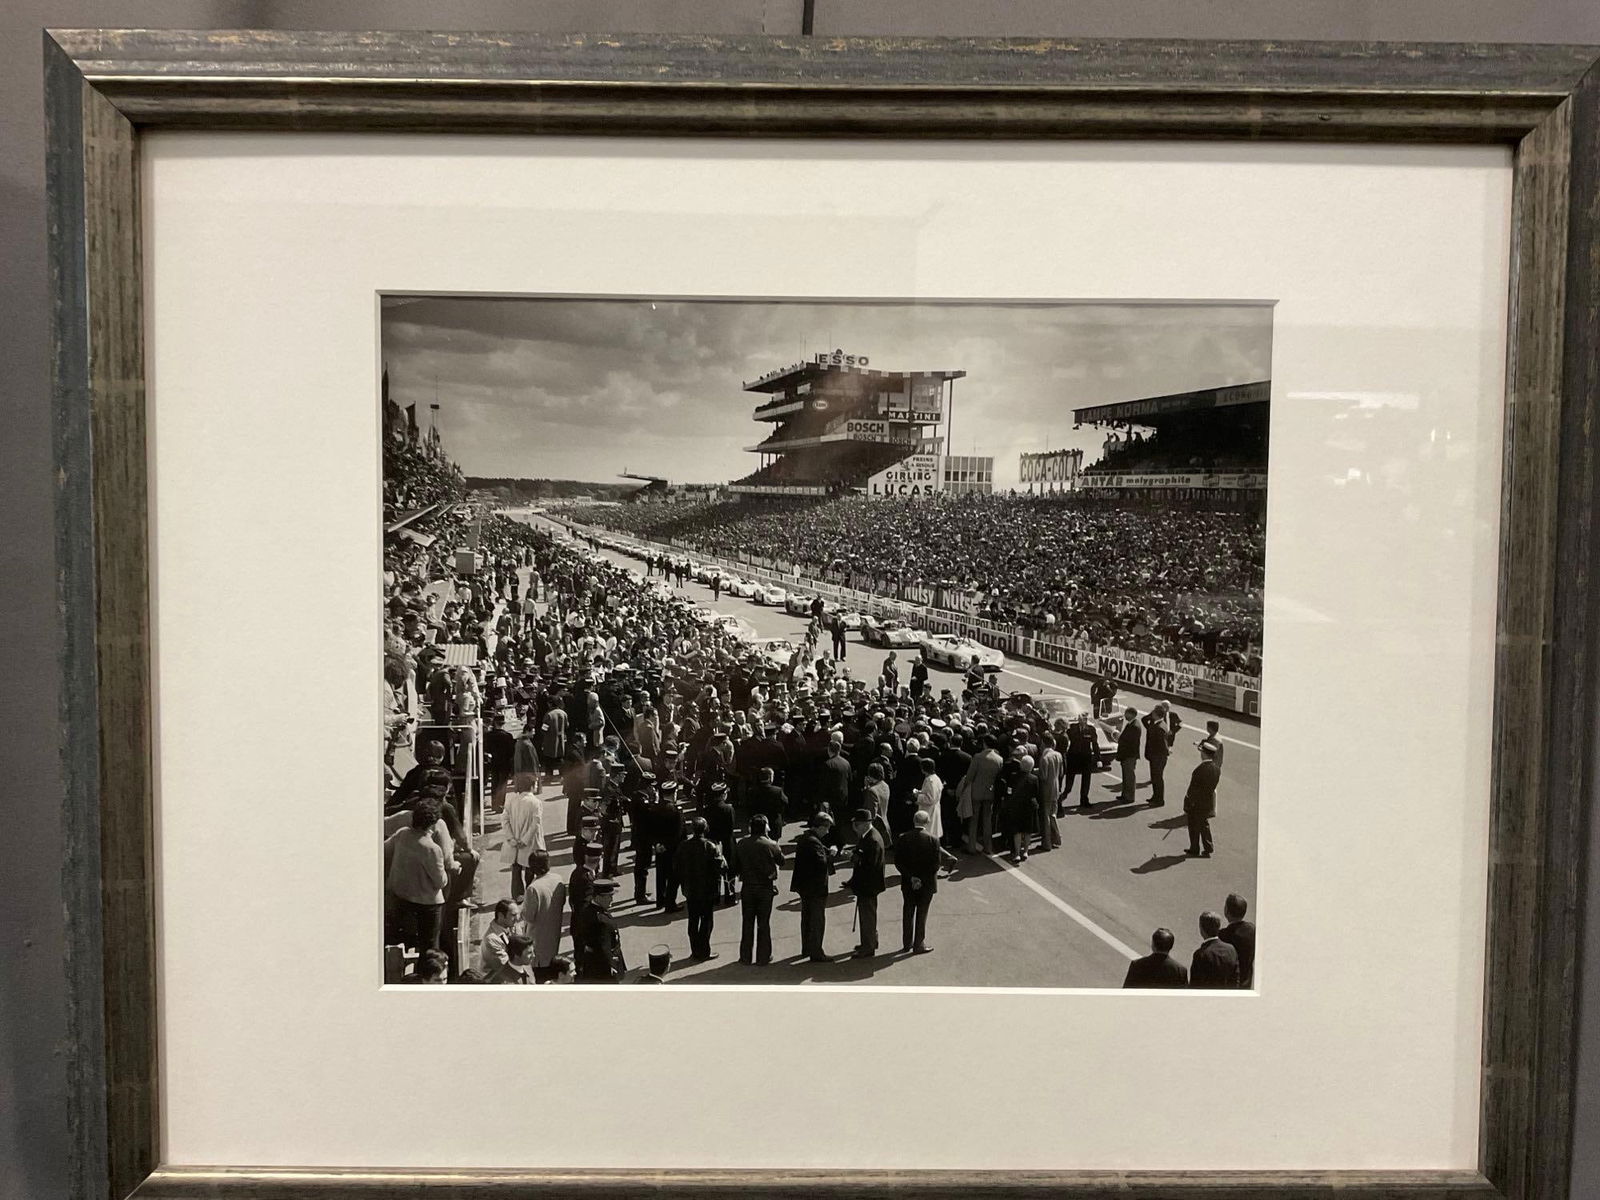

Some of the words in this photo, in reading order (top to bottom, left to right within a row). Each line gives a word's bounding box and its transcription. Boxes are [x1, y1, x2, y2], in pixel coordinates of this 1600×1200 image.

[818, 353, 869, 366] ESSO
[1117, 400, 1159, 418] NORMA
[847, 422, 884, 433] BOSCH
[1020, 454, 1078, 482] COCA-COLA
[886, 472, 931, 481] GIRLING
[873, 483, 934, 496] LUCAS
[1098, 655, 1175, 692] MOLYKOTE
